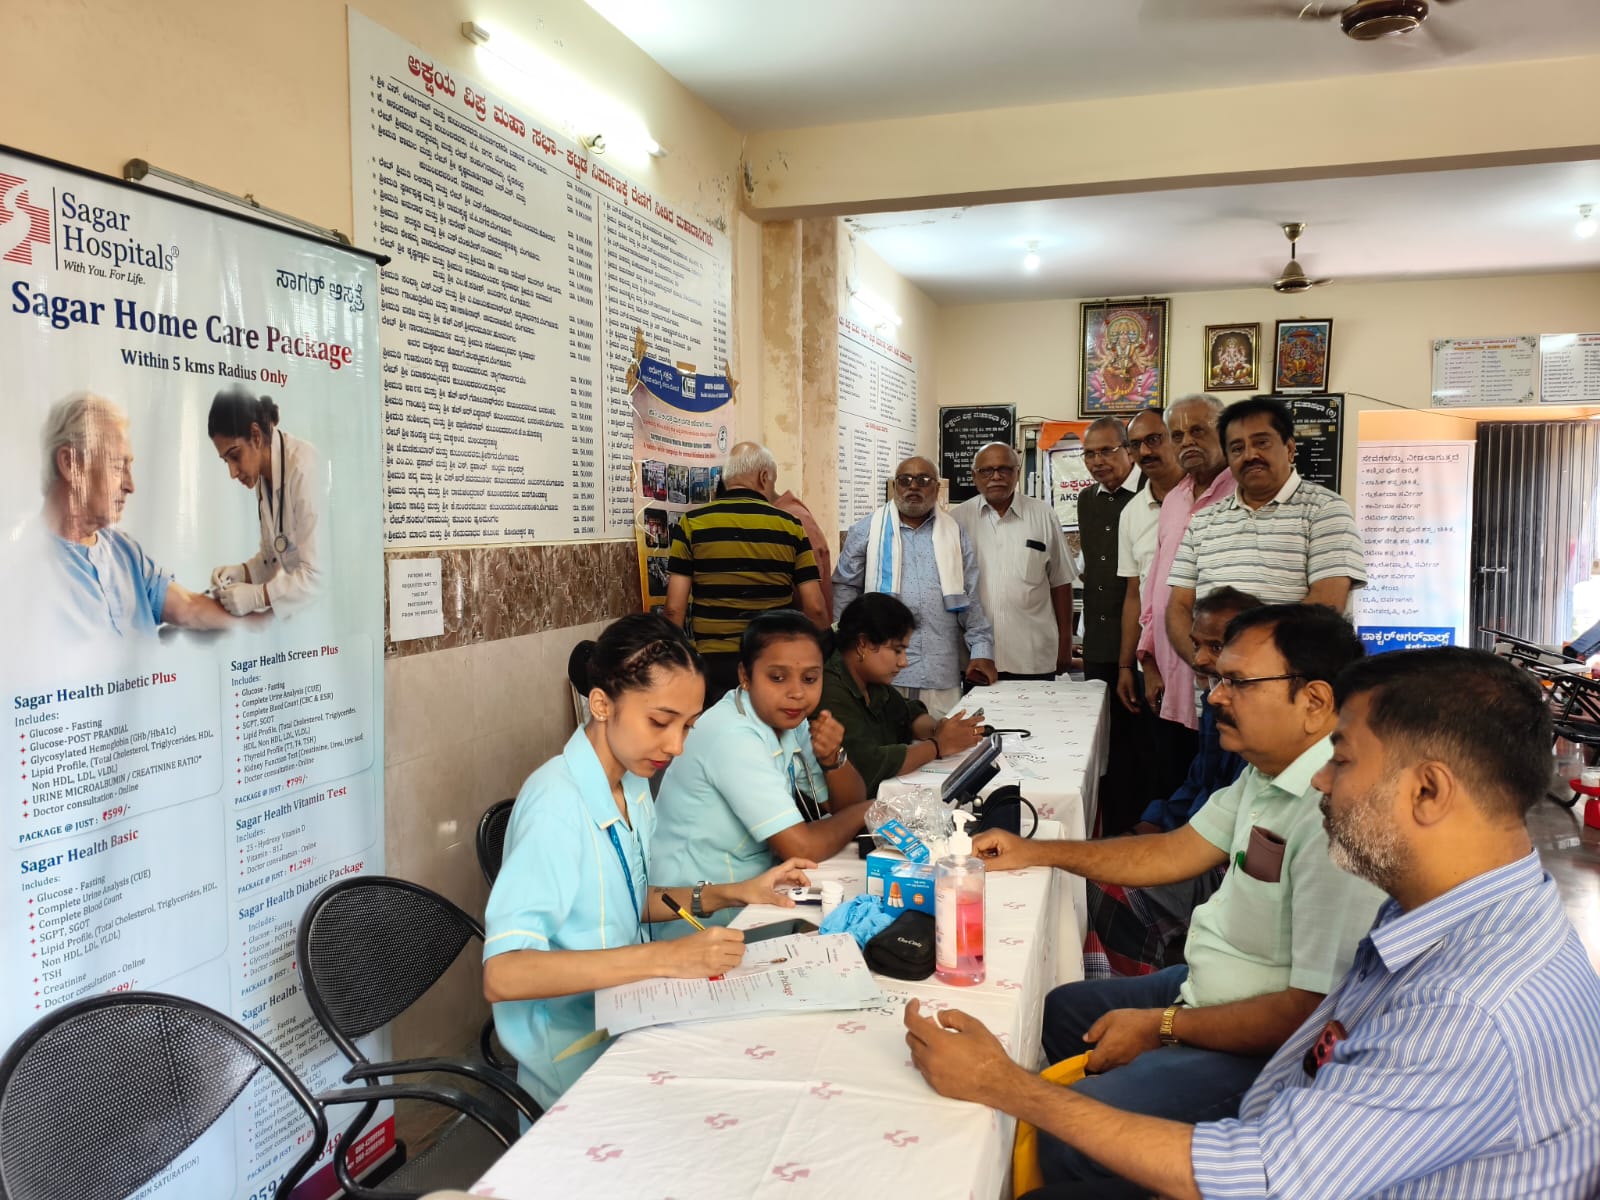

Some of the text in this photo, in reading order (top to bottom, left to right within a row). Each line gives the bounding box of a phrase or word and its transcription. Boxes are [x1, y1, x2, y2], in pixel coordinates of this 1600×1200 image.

[408, 54, 456, 97] ಅಕ್ಷಯ
[464, 86, 487, 122] ವಿಪ್ರ
[494, 105, 526, 138] ಮಹಾ
[62, 192, 130, 232] Sagar
[64, 260, 146, 285] With You. For Life.
[276, 269, 325, 295] ಸಾಗರ್
[12, 281, 353, 369] Sagar Home Care Package
[121, 349, 288, 387] Within 5 kms Radius Only
[231, 645, 338, 672] Sagar Health Screen Plus
[15, 672, 176, 710] Sagar Health Diabetic Plus
[15, 712, 58, 727] Includes:
[29, 720, 102, 738] Glucose Fasting
[30, 724, 129, 751] Glucose-POST PRANDIAL
[31, 746, 87, 765] Glycosylated
[32, 765, 53, 778] Lipid
[90, 753, 112, 767] (Total
[32, 790, 62, 804] URINE
[132, 761, 176, 778] CREATININE
[32, 782, 50, 791] Non
[33, 784, 138, 817] Doctor consultation Online
[235, 791, 261, 804] PACKAGE
[236, 787, 346, 830] Sagar Health Vitamin Test
[19, 804, 130, 843] PACKAGE JUST ₹599/-
[21, 830, 138, 874] Sagar Health Basic
[22, 877, 60, 891] Includes:
[37, 875, 105, 902] Glucose Fasting
[38, 898, 81, 915] Complete
[131, 870, 150, 884] (CUE)
[239, 861, 363, 920] Sagar Health Diabetic Package
[39, 893, 122, 928] Complete Blood Count
[69, 918, 90, 934] SGOT
[41, 941, 64, 956] Lipid
[42, 958, 61, 968] Non
[42, 969, 61, 981] TSH
[44, 973, 87, 994] Creatinine
[45, 958, 145, 1008] Doctor consultation Online
[242, 985, 297, 1021] Sagar Health
